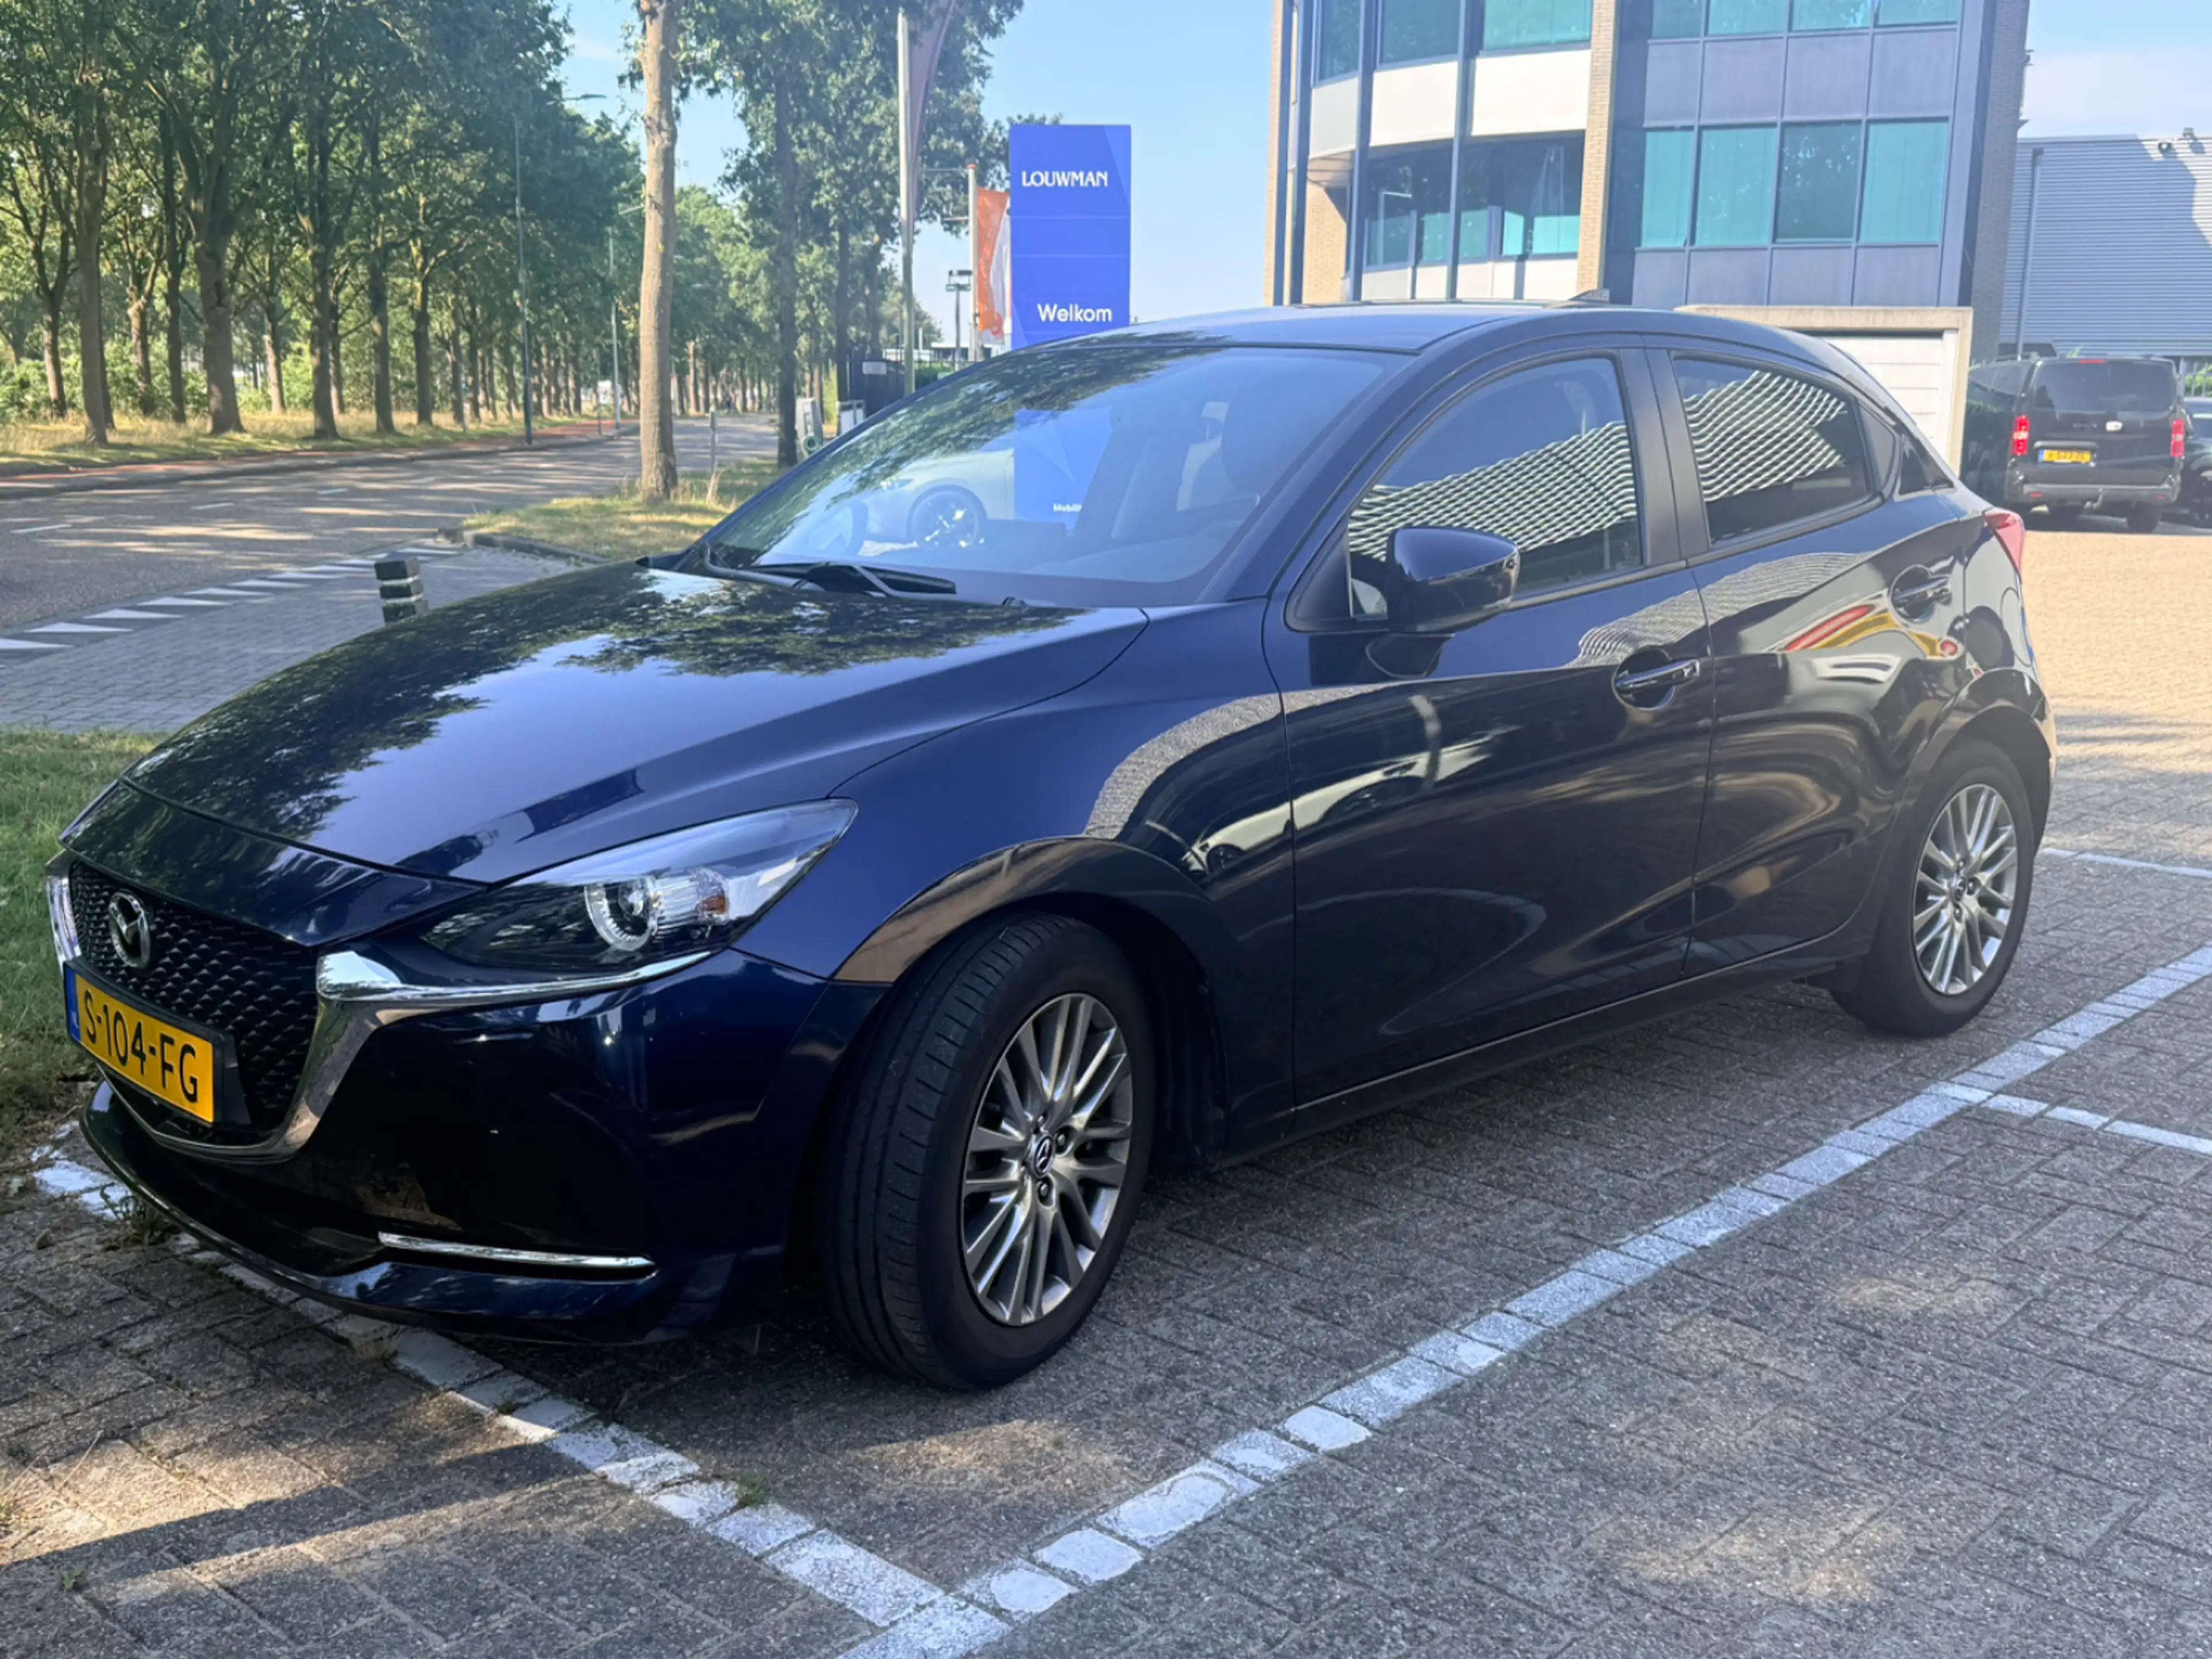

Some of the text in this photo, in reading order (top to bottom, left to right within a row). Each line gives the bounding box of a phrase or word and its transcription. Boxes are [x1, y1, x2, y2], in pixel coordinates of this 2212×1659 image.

[1022, 171, 1108, 187] LOUWMAN
[1037, 303, 1112, 323] Welkom
[84, 989, 198, 1104] S-104-FG
